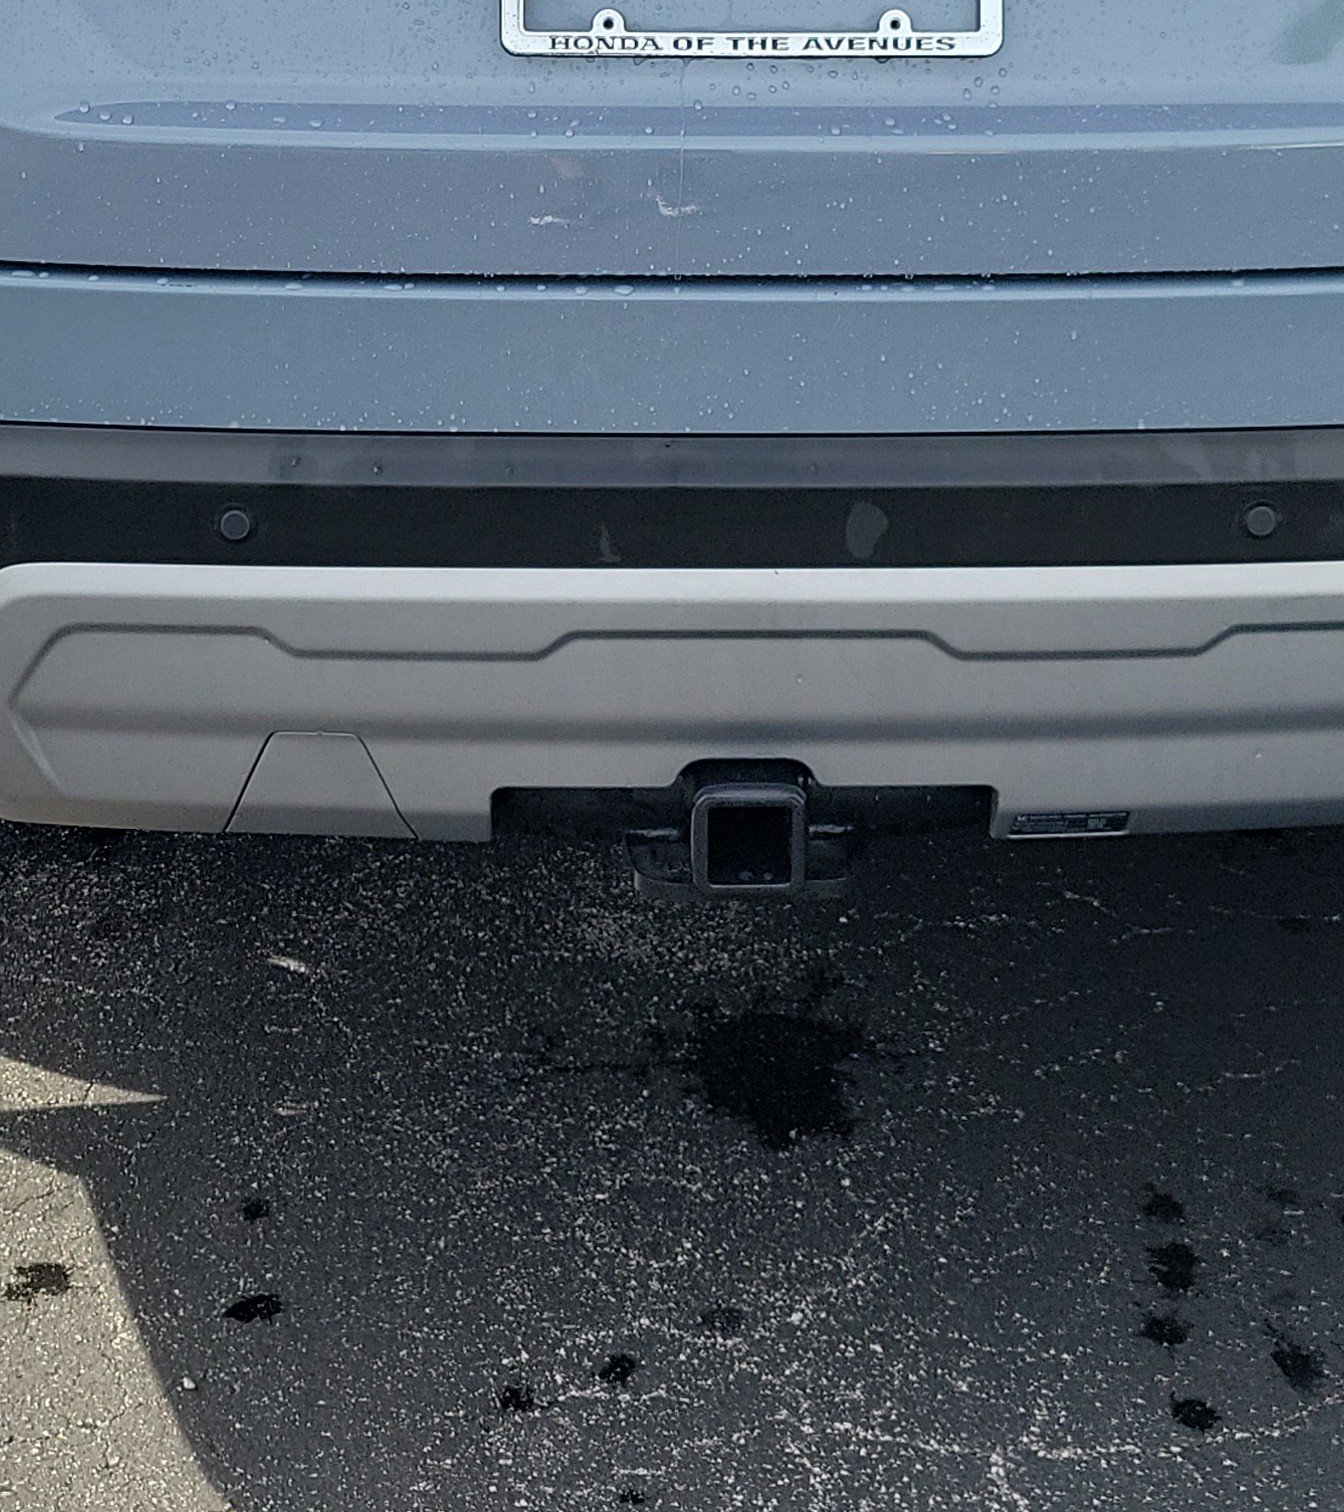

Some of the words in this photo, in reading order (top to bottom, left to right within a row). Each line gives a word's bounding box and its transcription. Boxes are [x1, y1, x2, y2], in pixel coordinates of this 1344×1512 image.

[549, 36, 663, 51] HONDA
[672, 36, 718, 51] OF
[729, 36, 791, 51] THE
[801, 36, 957, 52] AVENUES
